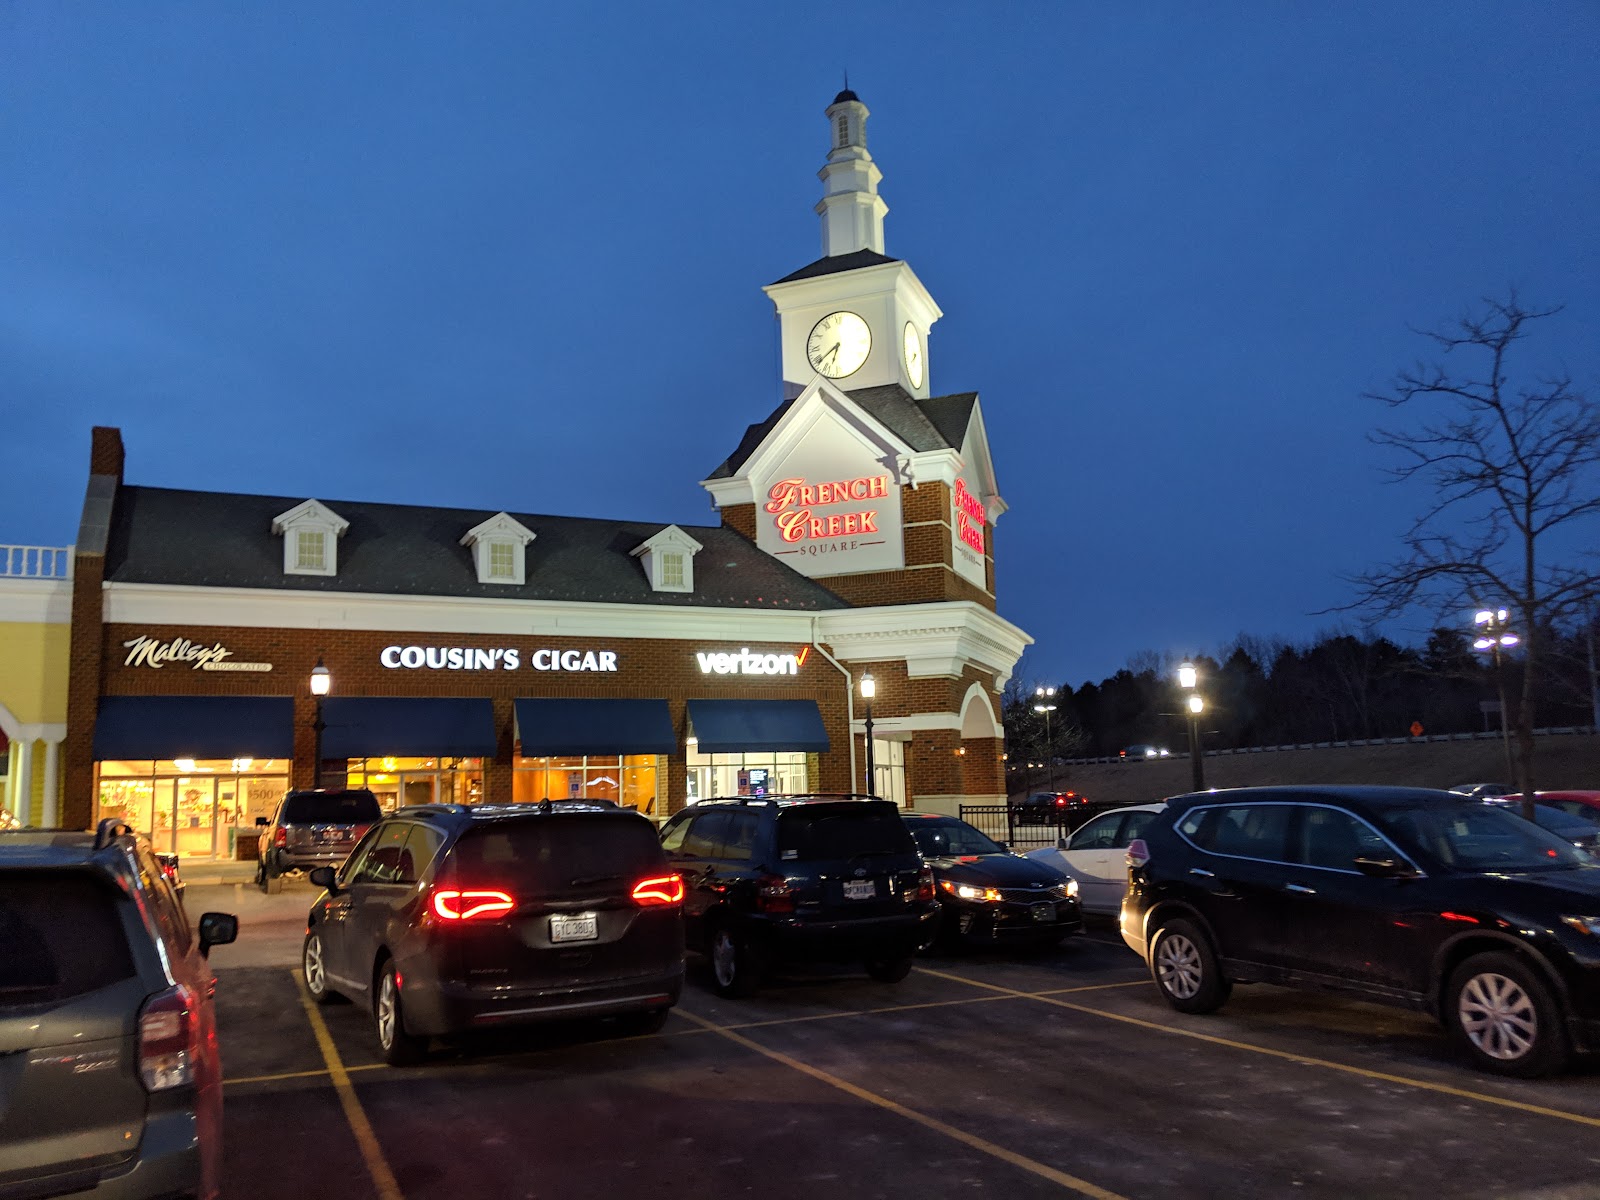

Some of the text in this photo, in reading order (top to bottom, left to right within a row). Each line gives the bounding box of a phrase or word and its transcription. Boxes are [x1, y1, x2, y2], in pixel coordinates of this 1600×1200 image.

[766, 476, 889, 513] FRENCH
[776, 508, 880, 543] CREEK
[800, 540, 859, 557] SQUARE
[123, 634, 234, 670] Malley's
[380, 645, 618, 673] COUSIN'S CIGAR
[696, 646, 798, 676] verizon
